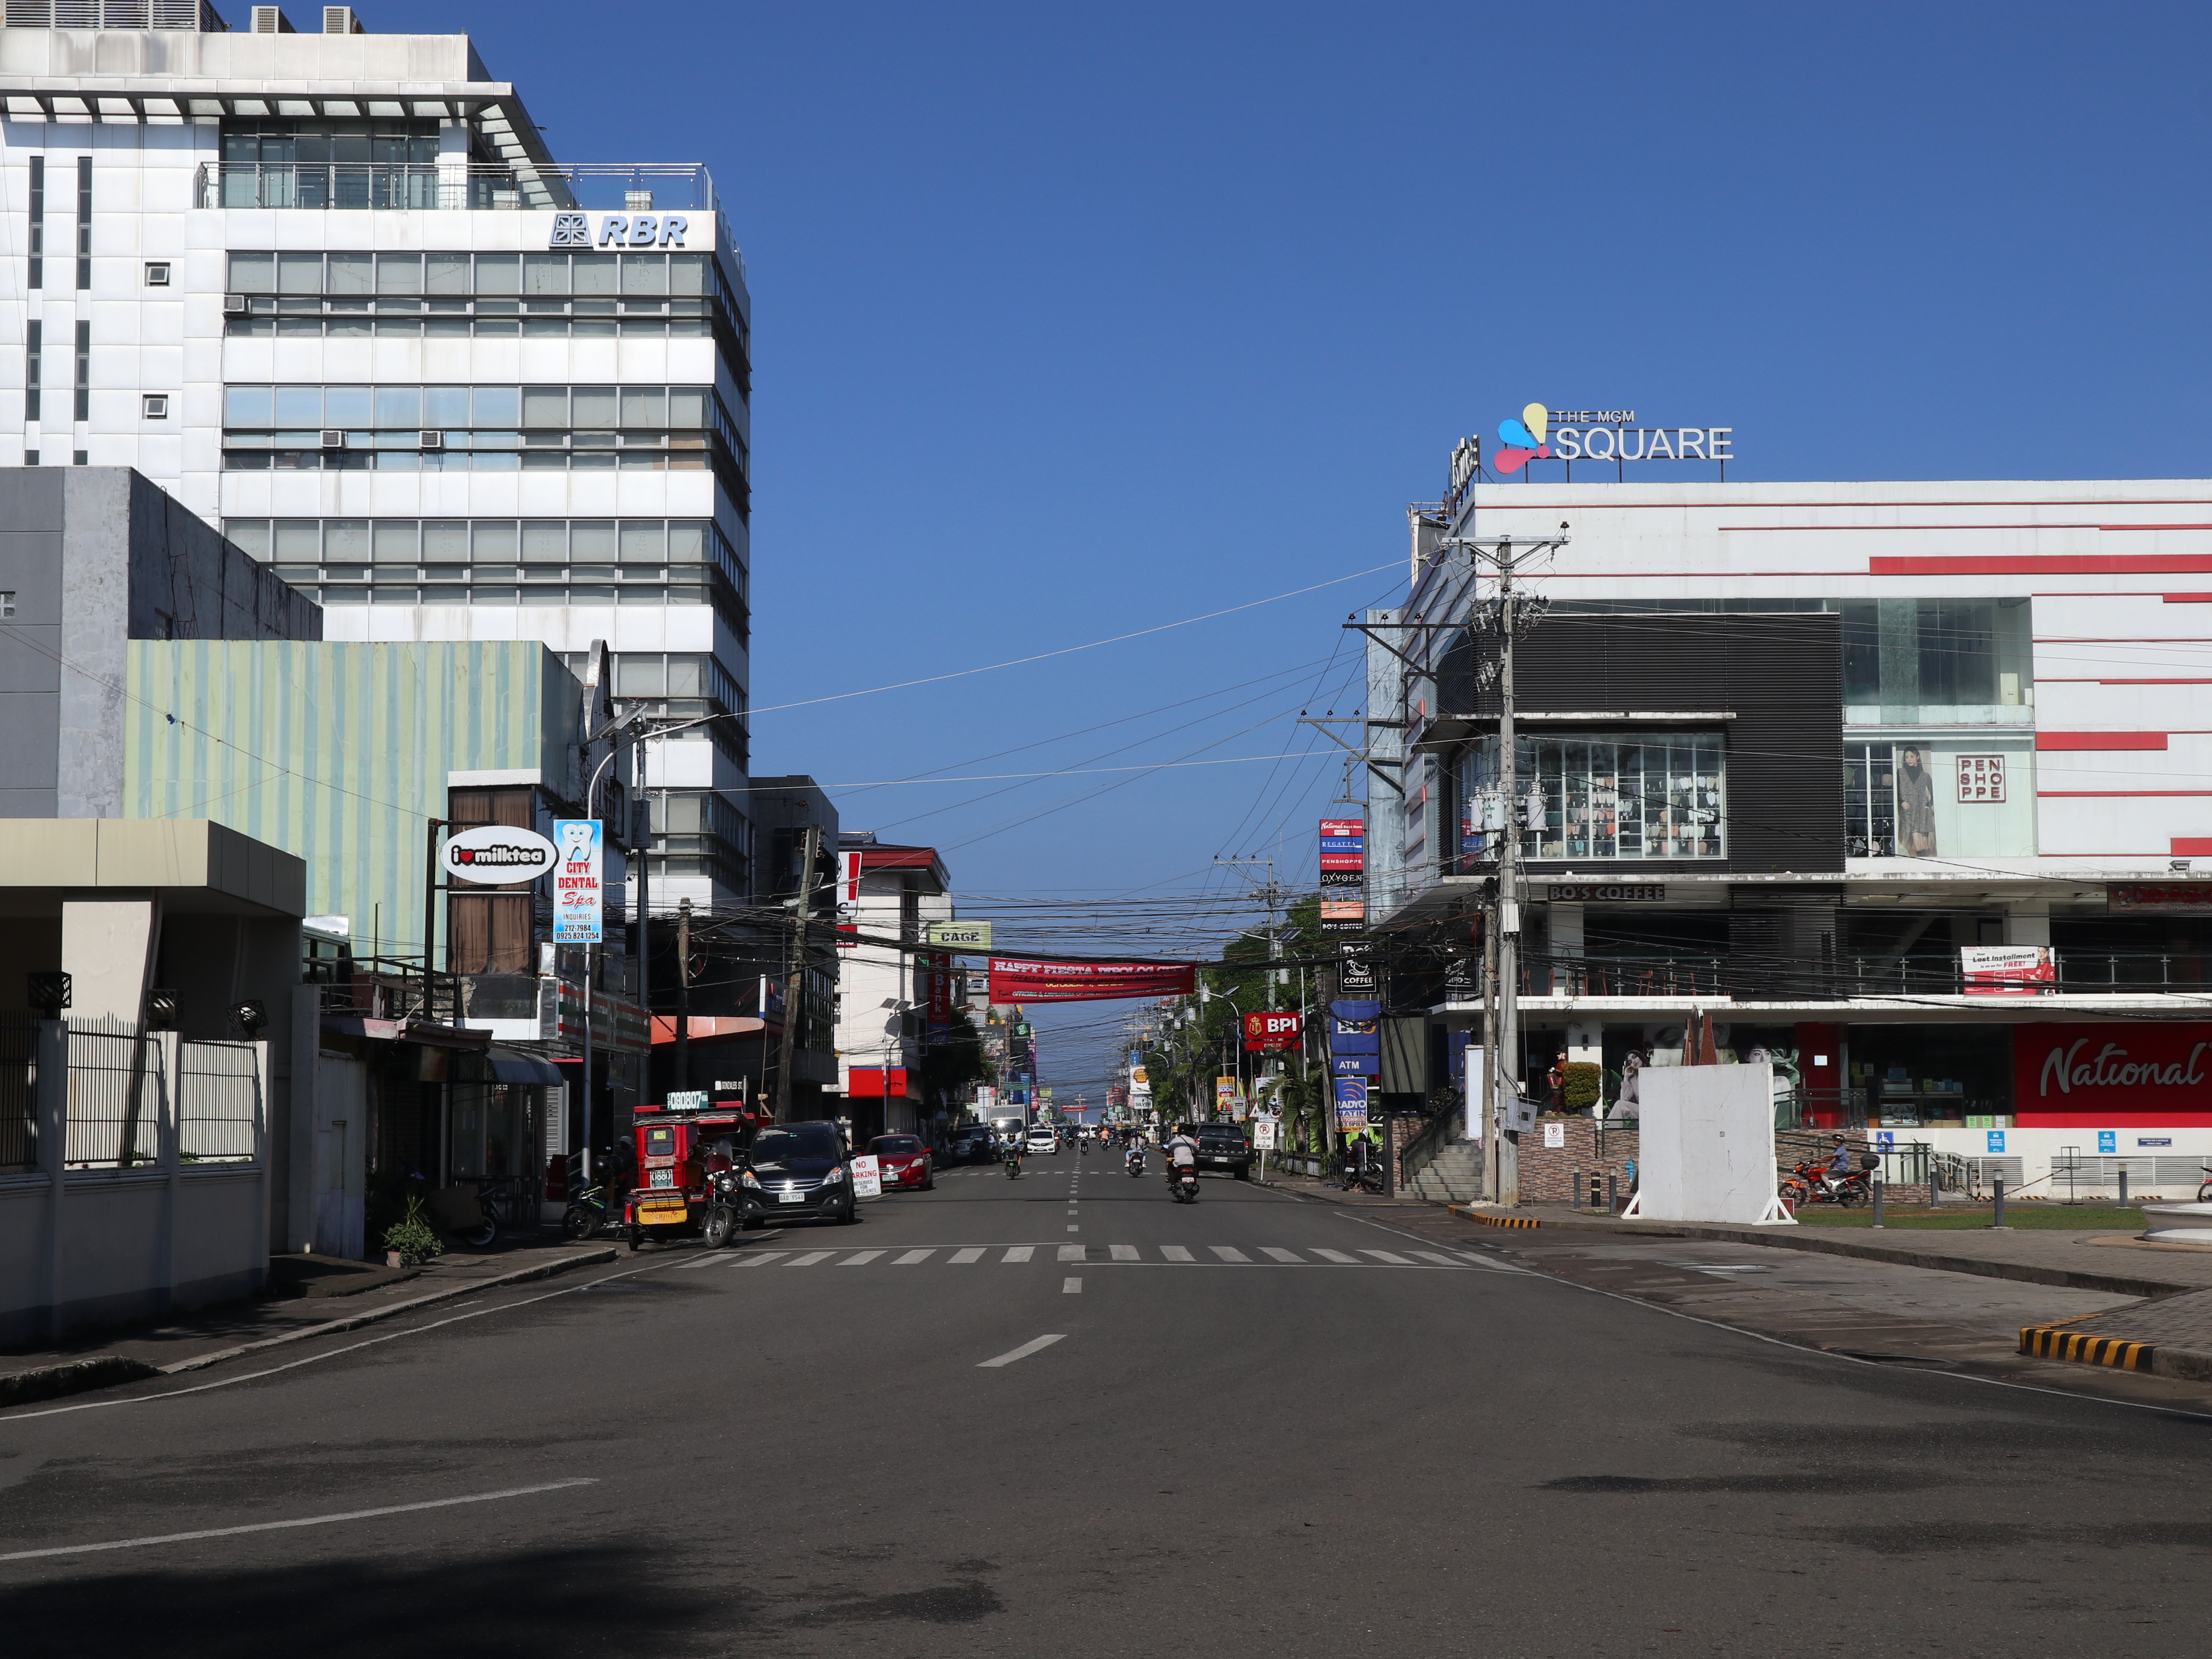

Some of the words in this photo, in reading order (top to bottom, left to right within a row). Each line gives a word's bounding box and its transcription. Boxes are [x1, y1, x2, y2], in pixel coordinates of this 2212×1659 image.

[598, 216, 688, 247] RBR
[1556, 410, 1590, 422] THE
[1597, 410, 1635, 422] MGM
[1555, 427, 1734, 462] SQUARE
[1961, 759, 2000, 772] PEN
[1960, 773, 2003, 785] SHO
[1962, 787, 2000, 799] PPE
[1321, 821, 1345, 830] National
[475, 847, 543, 863] milktea
[566, 862, 590, 874] CITY
[558, 877, 598, 889] DENTAL
[1321, 872, 1362, 884] OXYGEN
[1550, 886, 1590, 900] BO'S
[1595, 886, 1665, 900] COFFEE
[562, 891, 596, 909] Spa
[564, 924, 591, 932] 212-7984
[941, 932, 980, 942] CAGE
[1992, 952, 2036, 962] Installment
[995, 961, 1042, 973] HAPPY
[1043, 965, 1094, 975] FIESTA
[1097, 966, 1154, 975] DIPOLOG
[1267, 1017, 1297, 1033] BPI
[1339, 1061, 1359, 1069] ATM
[2040, 1038, 2207, 1097] National
[722, 1081, 737, 1090] GONZALES
[671, 1091, 702, 1110] 090807
[1335, 1099, 1366, 1109] RADYO
[856, 1161, 866, 1169] NO
[651, 1171, 671, 1181] 0880
[851, 1170, 877, 1179] ARKING
